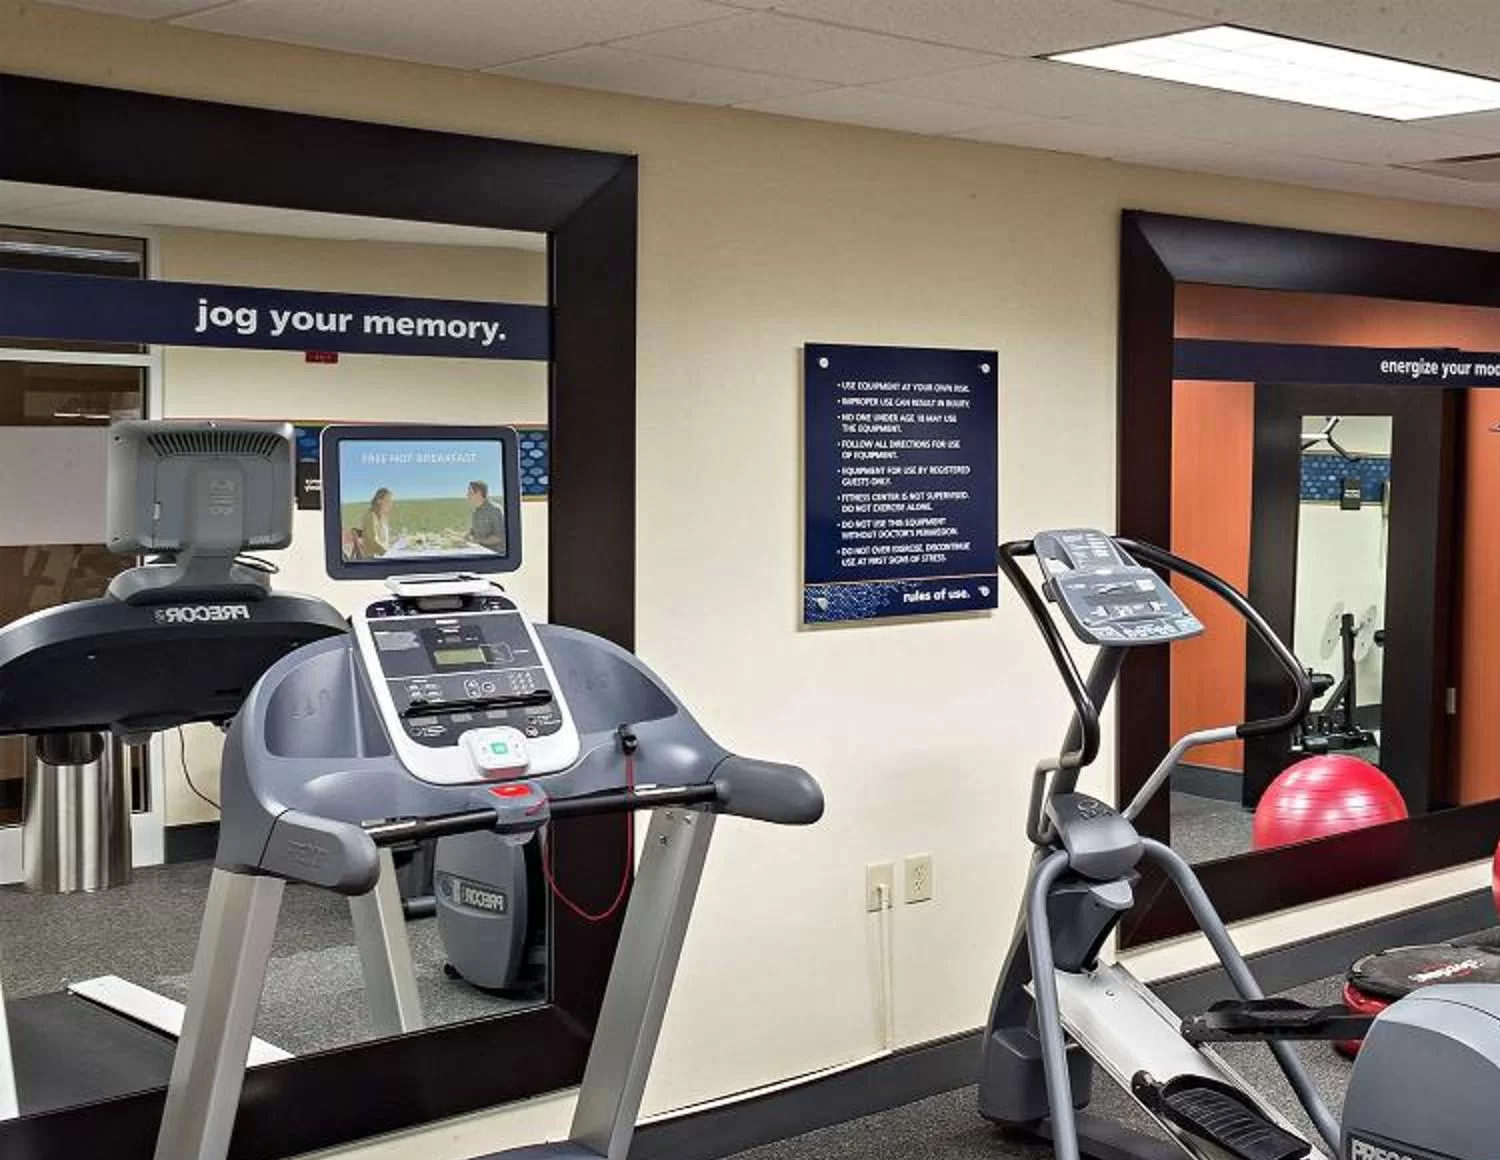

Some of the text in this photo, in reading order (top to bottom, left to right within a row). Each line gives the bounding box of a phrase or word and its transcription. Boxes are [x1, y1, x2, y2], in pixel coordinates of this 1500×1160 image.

[195, 299, 507, 347] jog your memory.
[1380, 358, 1439, 379] energize
[1441, 361, 1472, 379] your
[858, 382, 900, 391] EQUIPMENT
[912, 383, 932, 392] YOUR
[841, 440, 873, 449] FOLLOW
[903, 587, 971, 603] rules of use.
